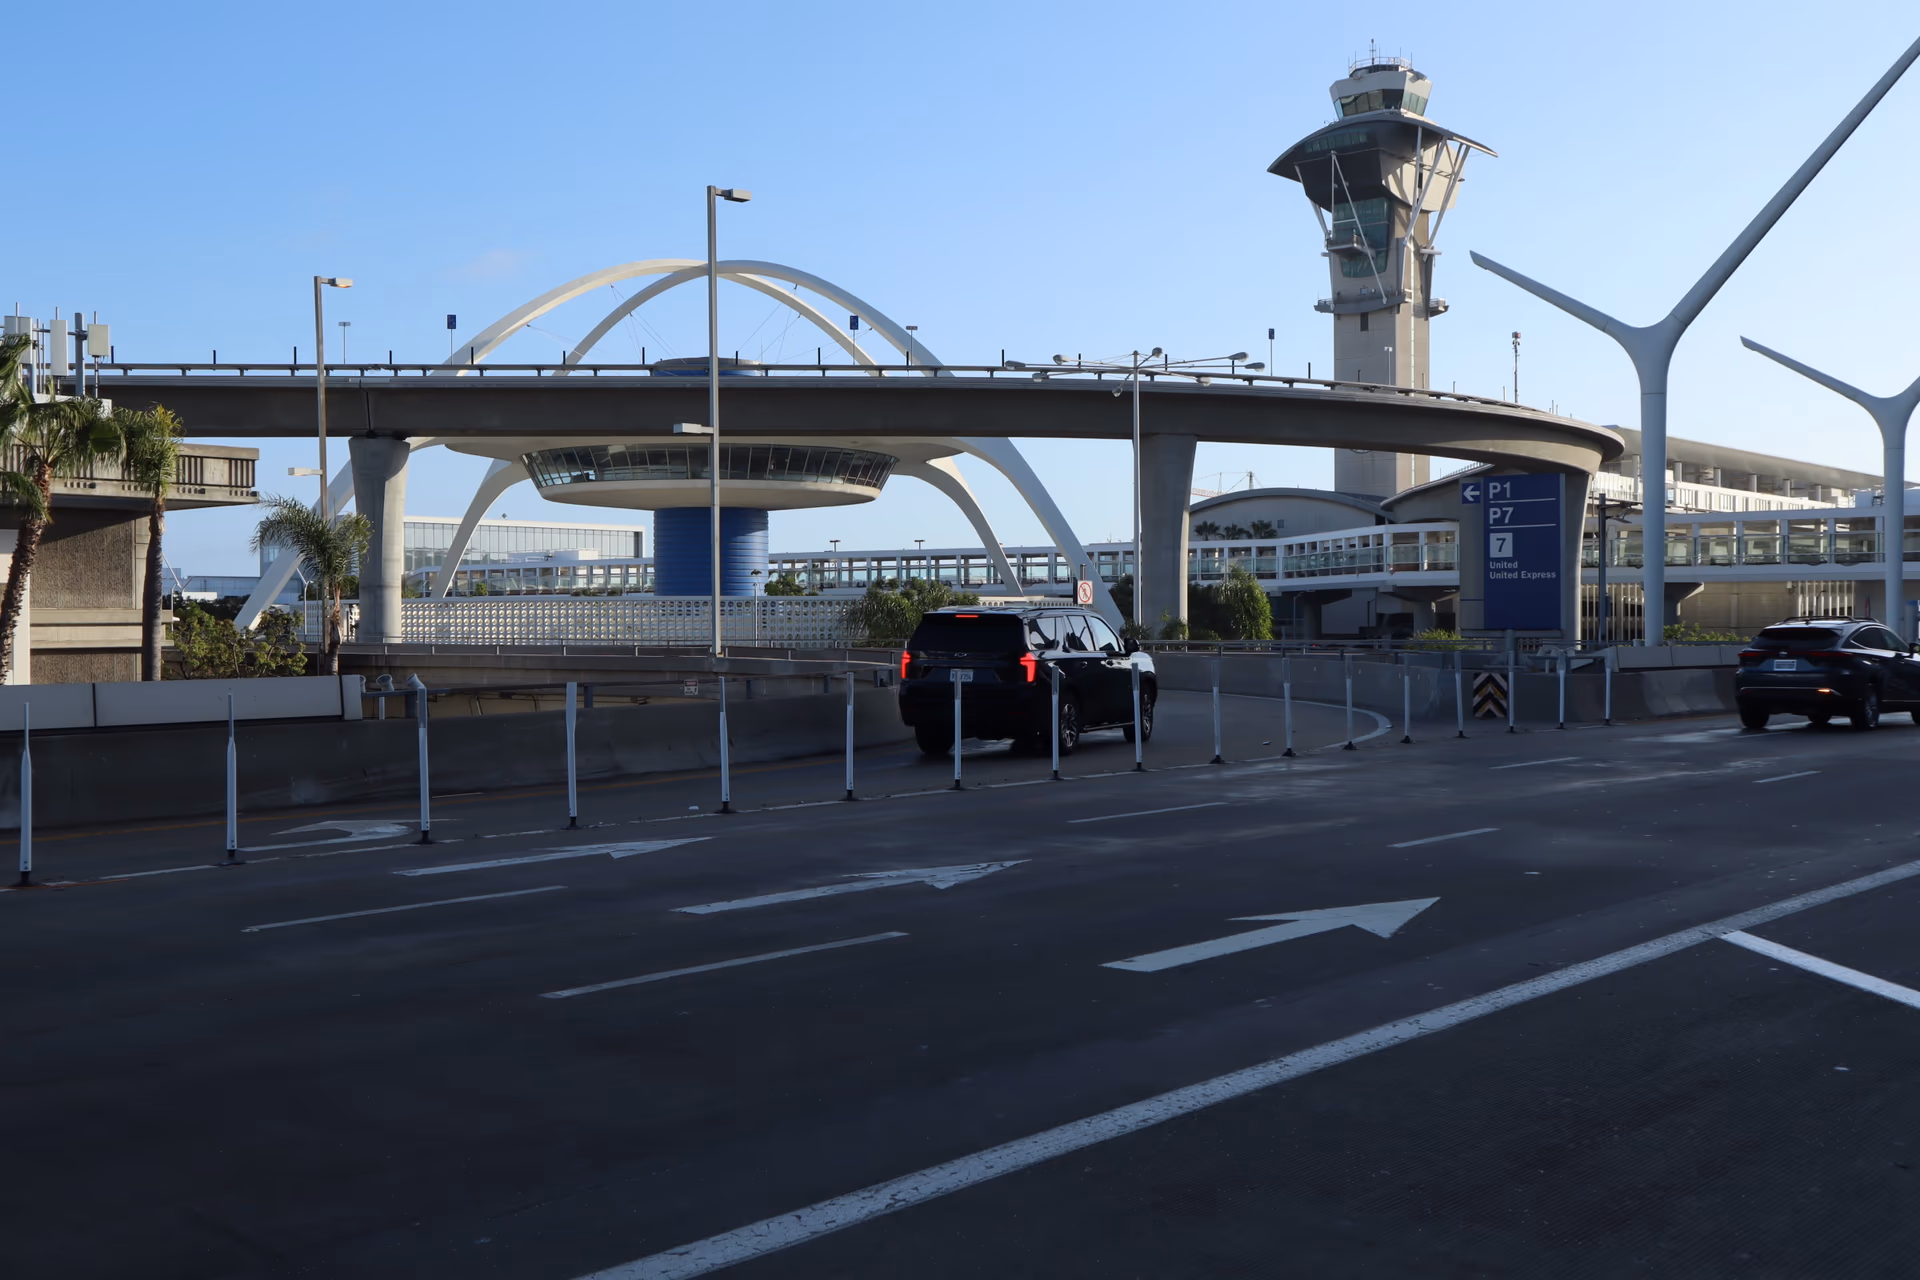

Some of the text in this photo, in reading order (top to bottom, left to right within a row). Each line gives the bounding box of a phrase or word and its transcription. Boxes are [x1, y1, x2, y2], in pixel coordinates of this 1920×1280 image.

[1489, 482, 1511, 499] P1
[1489, 507, 1514, 524] P7
[1496, 537, 1507, 553] 7
[1490, 561, 1518, 569] United
[1490, 571, 1557, 580] United Express
